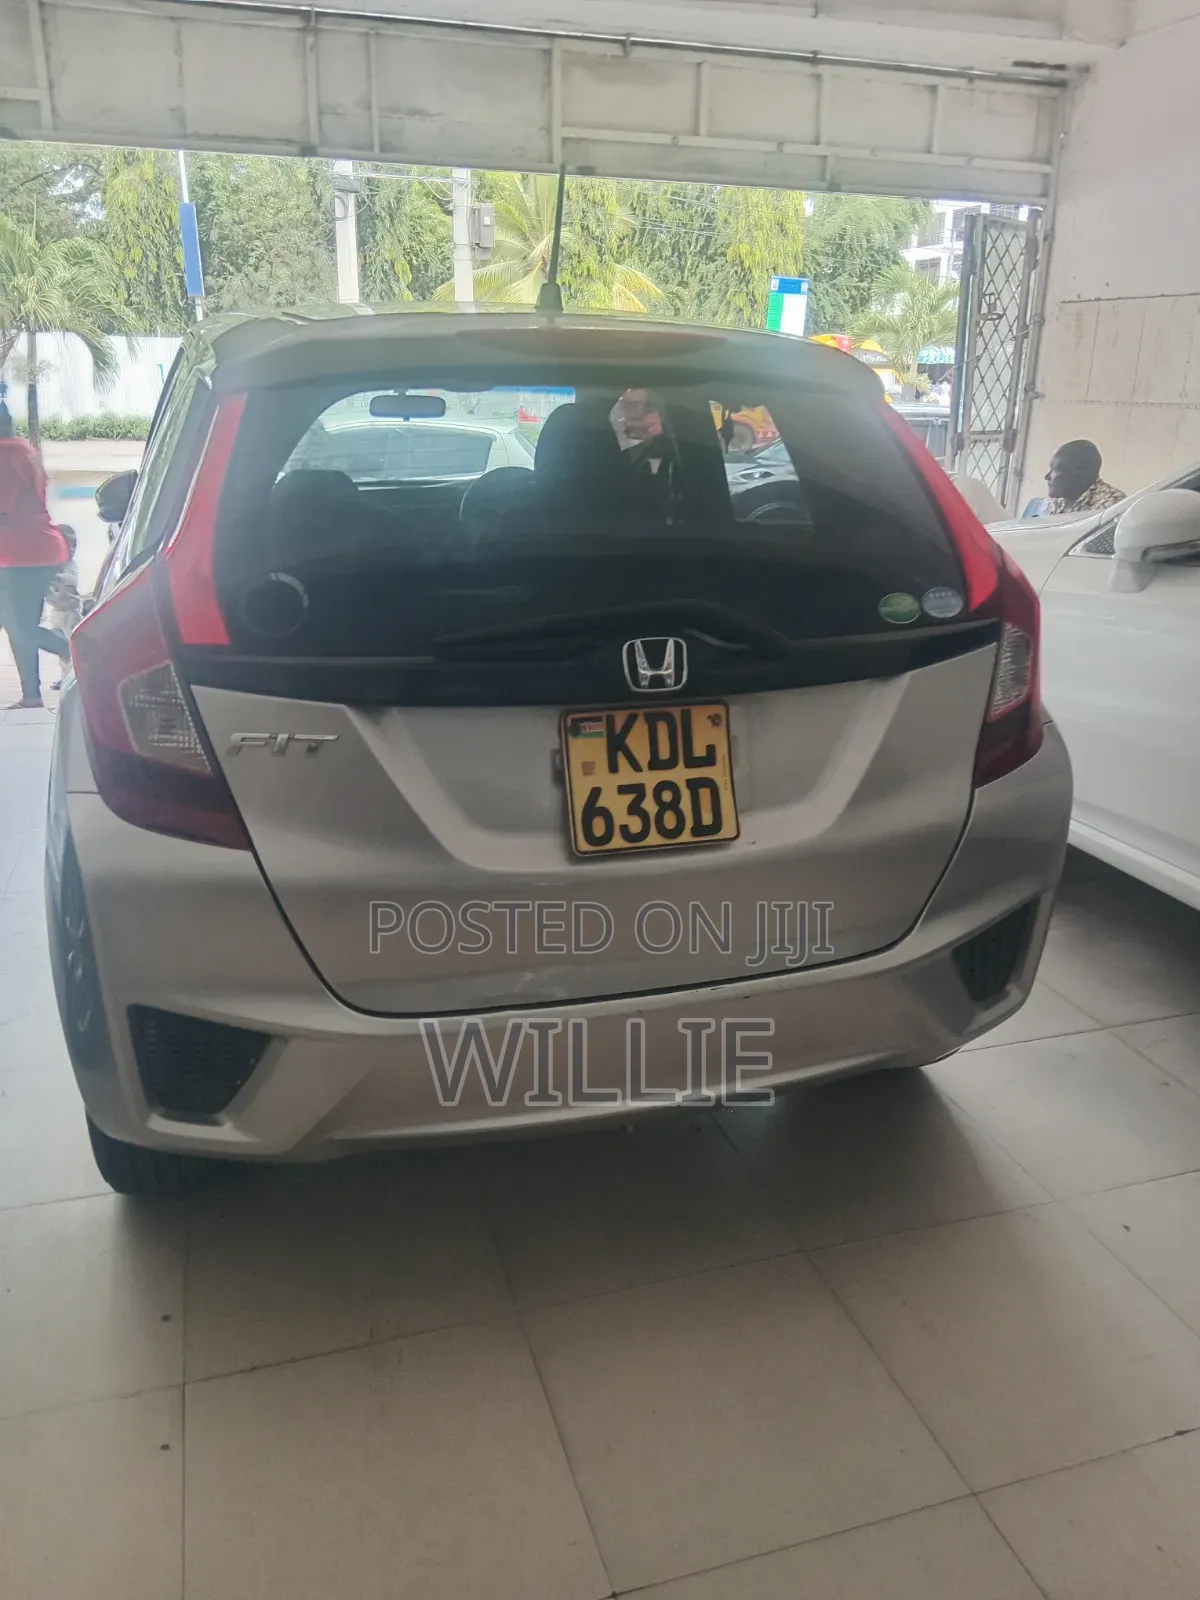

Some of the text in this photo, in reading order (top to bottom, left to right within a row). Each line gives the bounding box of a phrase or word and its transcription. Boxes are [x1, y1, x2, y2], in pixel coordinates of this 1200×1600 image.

[226, 732, 340, 757] FIT
[605, 708, 717, 774] KDL
[581, 776, 723, 847] 638D
